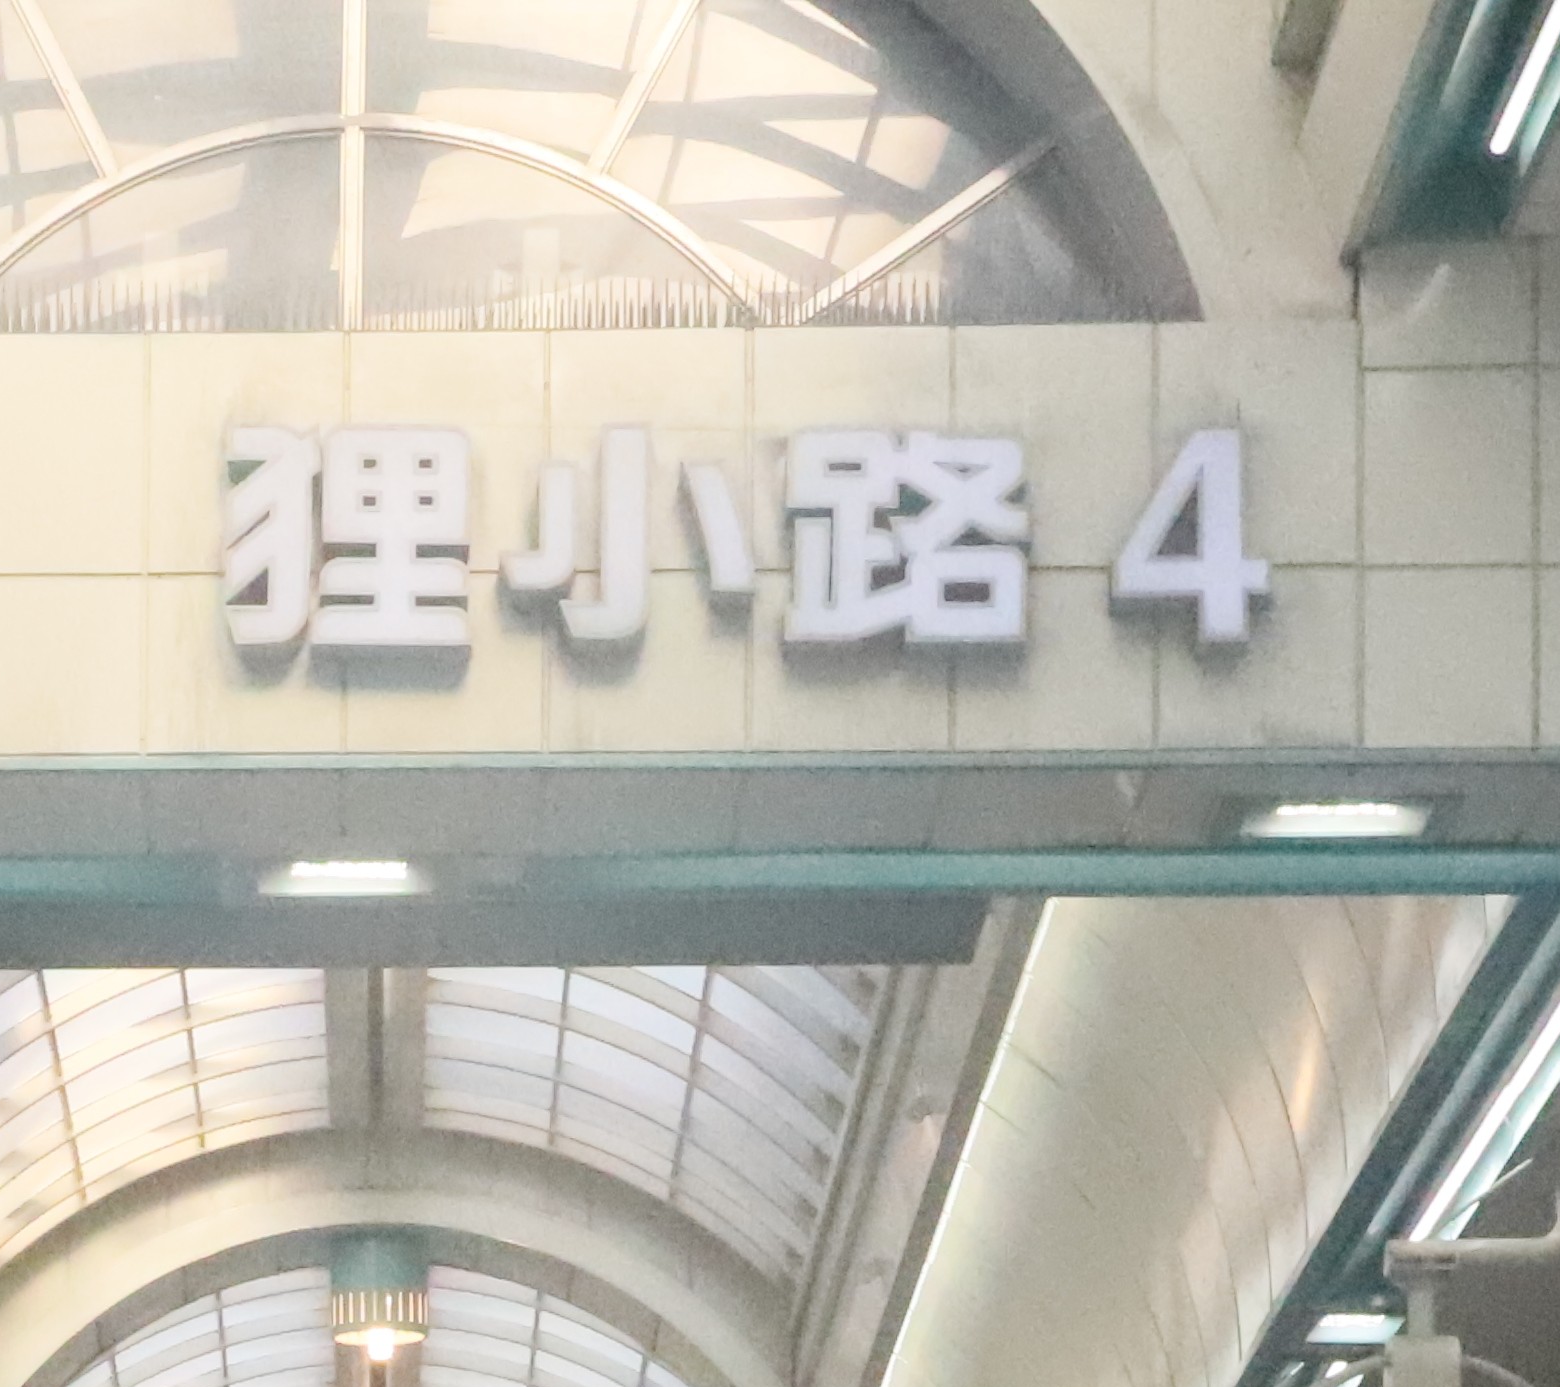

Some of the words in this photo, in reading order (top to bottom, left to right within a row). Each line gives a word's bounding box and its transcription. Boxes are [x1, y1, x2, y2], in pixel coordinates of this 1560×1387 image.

[220, 426, 1028, 656] 狸小路
[1109, 431, 1275, 643] 4
